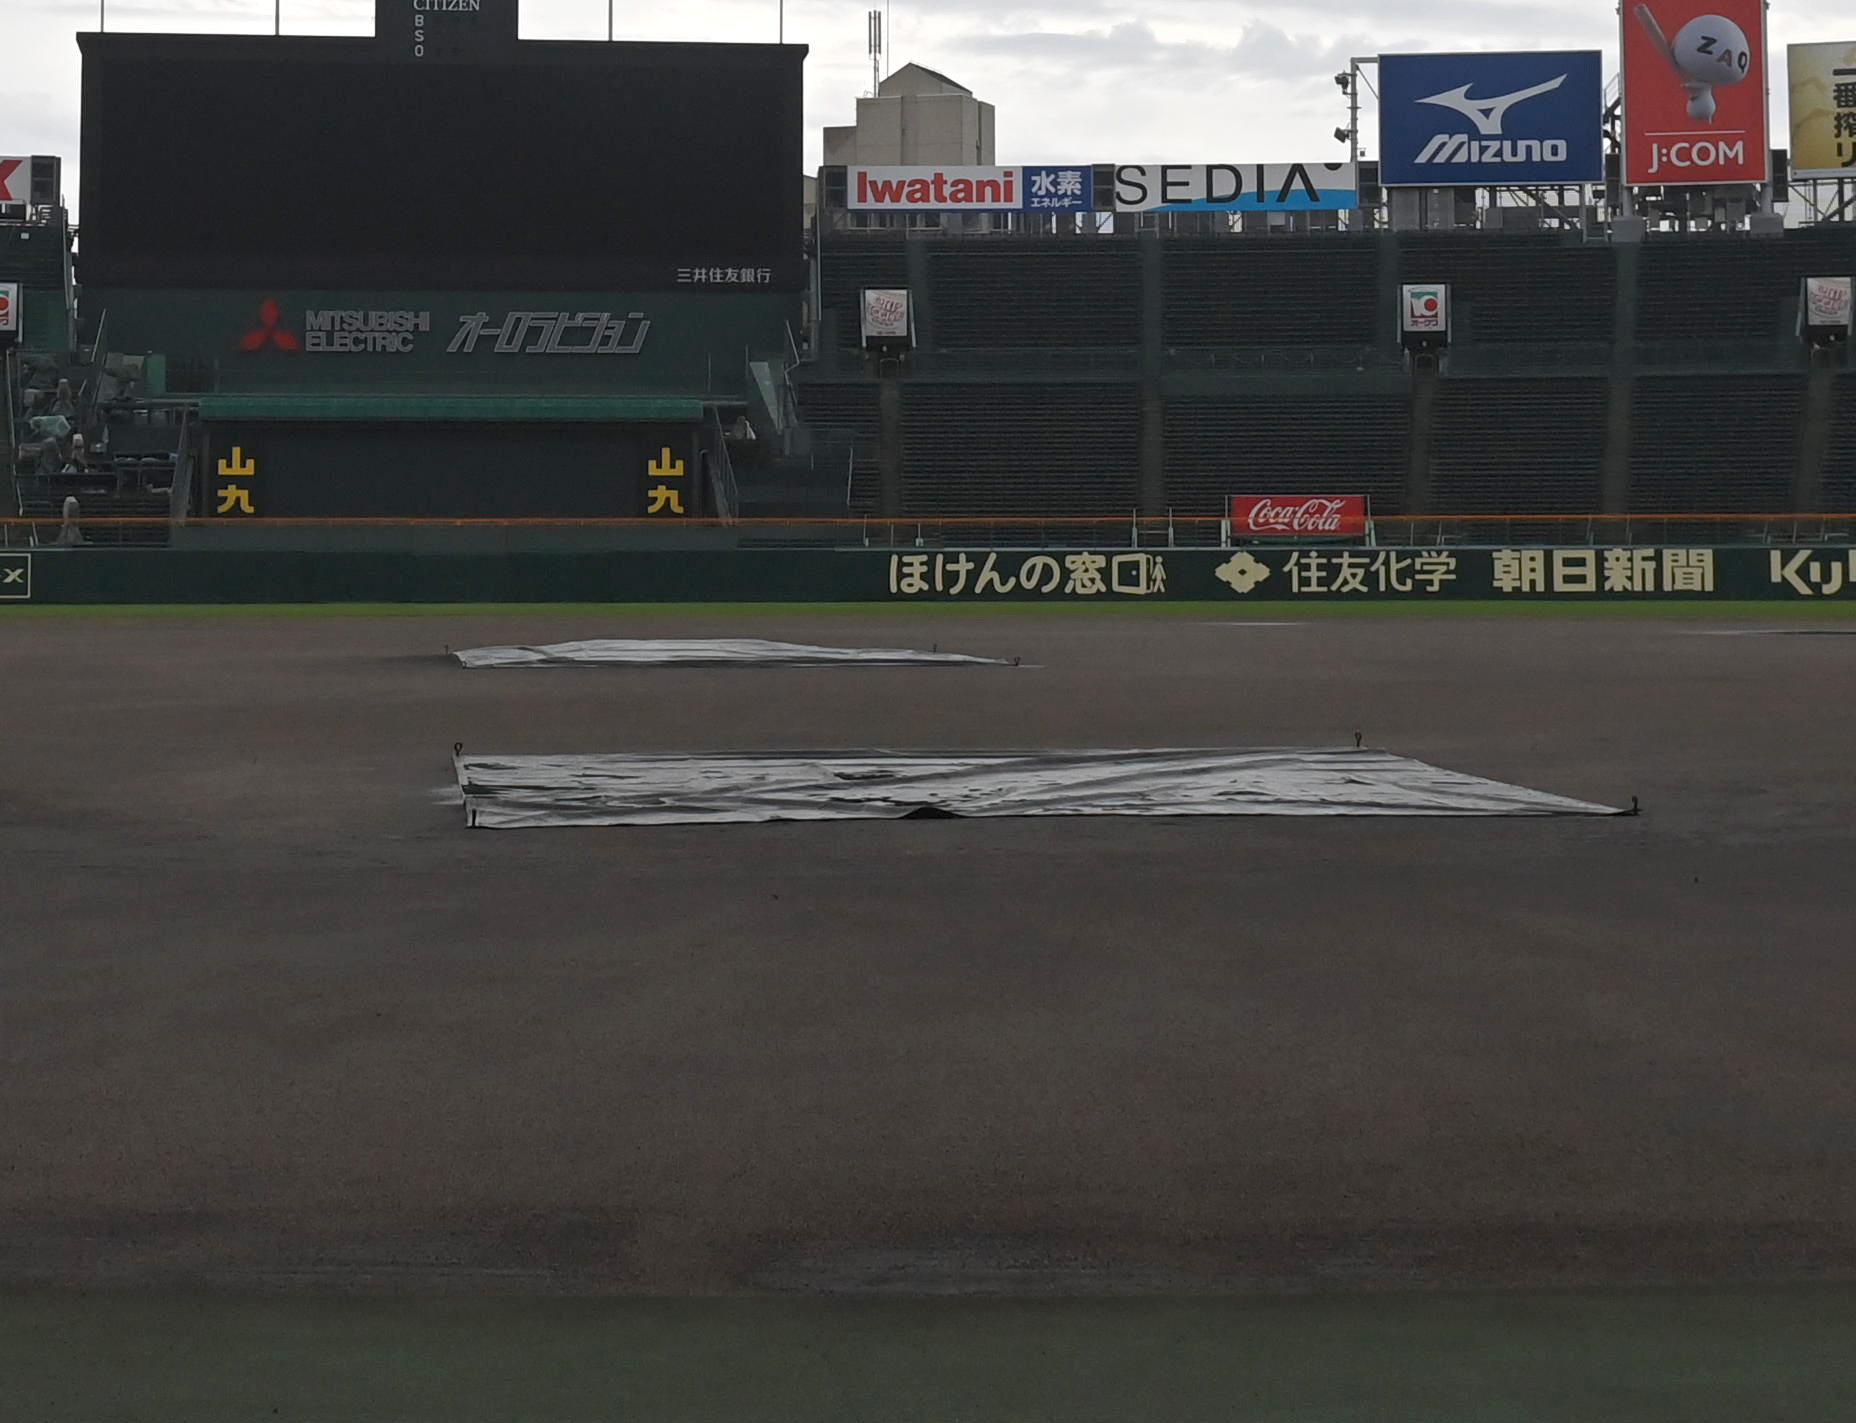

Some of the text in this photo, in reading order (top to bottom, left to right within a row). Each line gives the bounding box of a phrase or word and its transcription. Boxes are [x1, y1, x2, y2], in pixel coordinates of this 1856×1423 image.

[414, 14, 425, 27] B
[414, 29, 425, 42] S
[1647, 139, 1745, 174] J:COM
[857, 171, 1014, 204] Iwatani
[1030, 170, 1083, 195] 水素
[1115, 163, 1322, 205] SEDIA
[1030, 196, 1083, 208] エネルギー
[675, 267, 772, 284] 三井住友銀行
[305, 310, 430, 332] MITSUBISHI
[446, 311, 652, 354] オーロラビジョン
[305, 331, 414, 353] ELECTRIC
[217, 446, 256, 514] 山九
[647, 446, 685, 514] 山九
[1247, 498, 1347, 532] Coca-Cola
[889, 551, 1151, 595] ほけんの窓口
[1282, 550, 1457, 594] 住友化学
[1491, 548, 1716, 593] 朝日新聞
